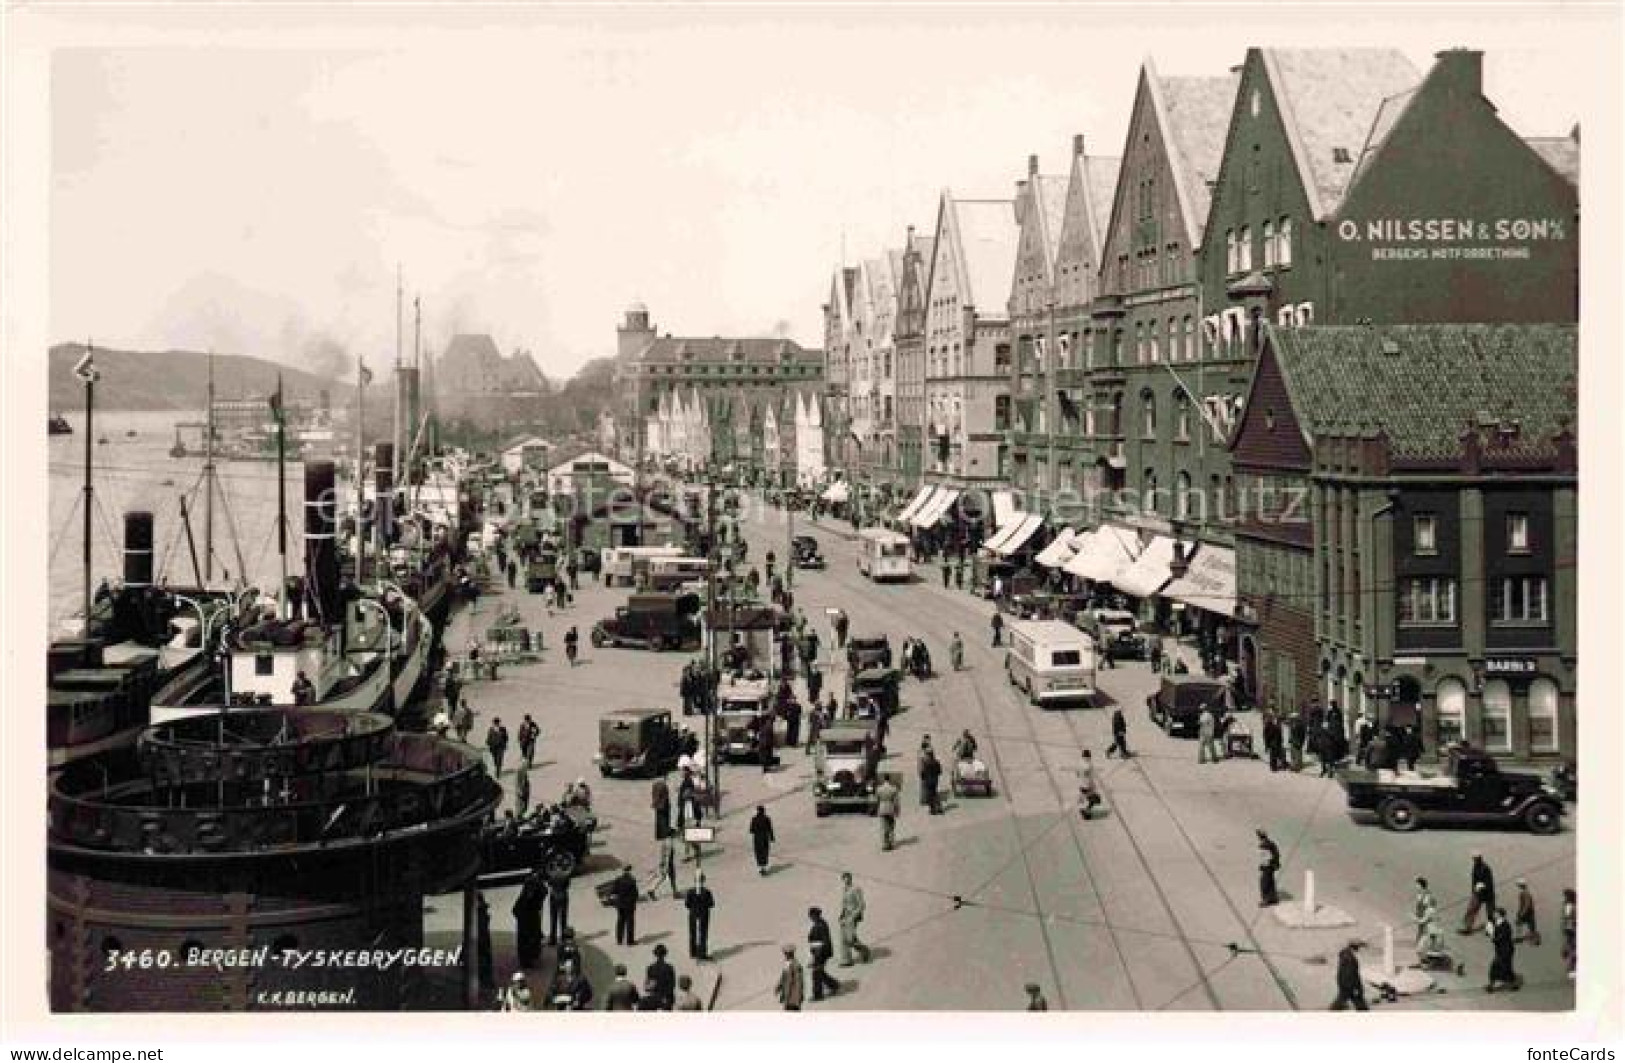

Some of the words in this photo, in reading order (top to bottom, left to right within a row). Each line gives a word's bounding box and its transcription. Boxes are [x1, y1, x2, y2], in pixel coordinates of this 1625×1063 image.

[1338, 219, 1361, 242] O.
[1366, 219, 1474, 242] NILSSEN
[1477, 221, 1491, 241] &
[1494, 219, 1548, 242] SØN
